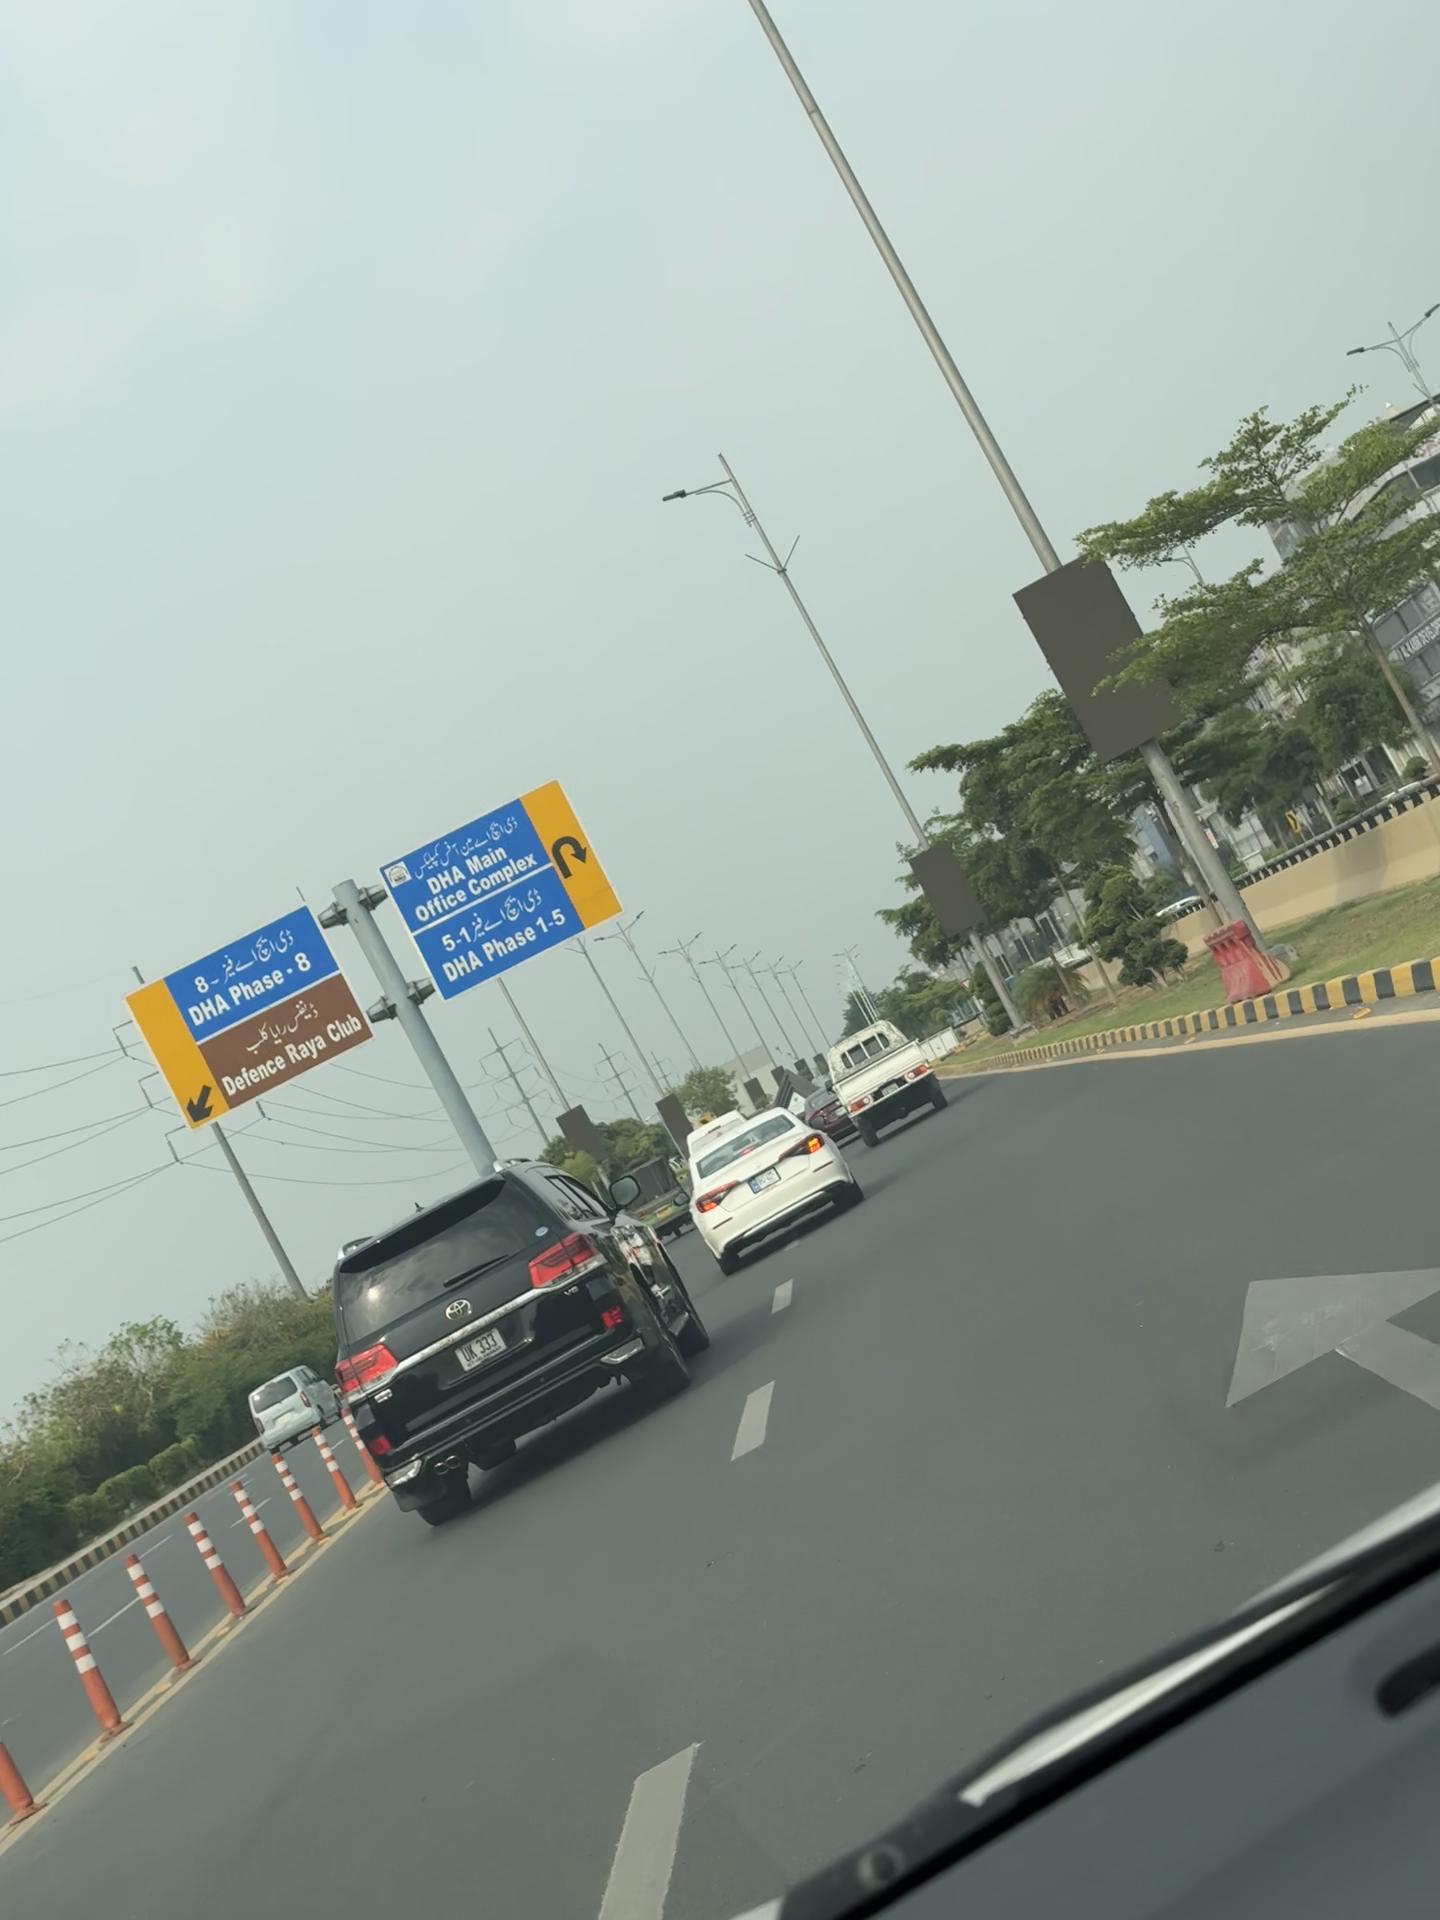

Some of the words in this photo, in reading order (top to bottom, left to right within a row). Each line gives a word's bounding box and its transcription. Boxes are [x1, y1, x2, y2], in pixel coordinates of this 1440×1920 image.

[503, 816, 519, 834] ڈی
[415, 890, 467, 921] Office
[467, 853, 538, 896] Complex
[426, 866, 466, 895] DHA
[465, 848, 507, 875] Main
[523, 888, 542, 912] ڈی
[275, 929, 294, 953] ڈی
[442, 950, 483, 982] DHA
[481, 926, 537, 962] Phase
[536, 908, 566, 933] 1-5
[188, 993, 230, 1026] DHA
[228, 969, 284, 1006] Phase
[294, 952, 311, 971] 8
[221, 1054, 286, 1096] Defence
[284, 1034, 327, 1063] Raya
[326, 1013, 362, 1042] Club
[462, 1344, 478, 1362] UK
[475, 1333, 497, 1354] 333
